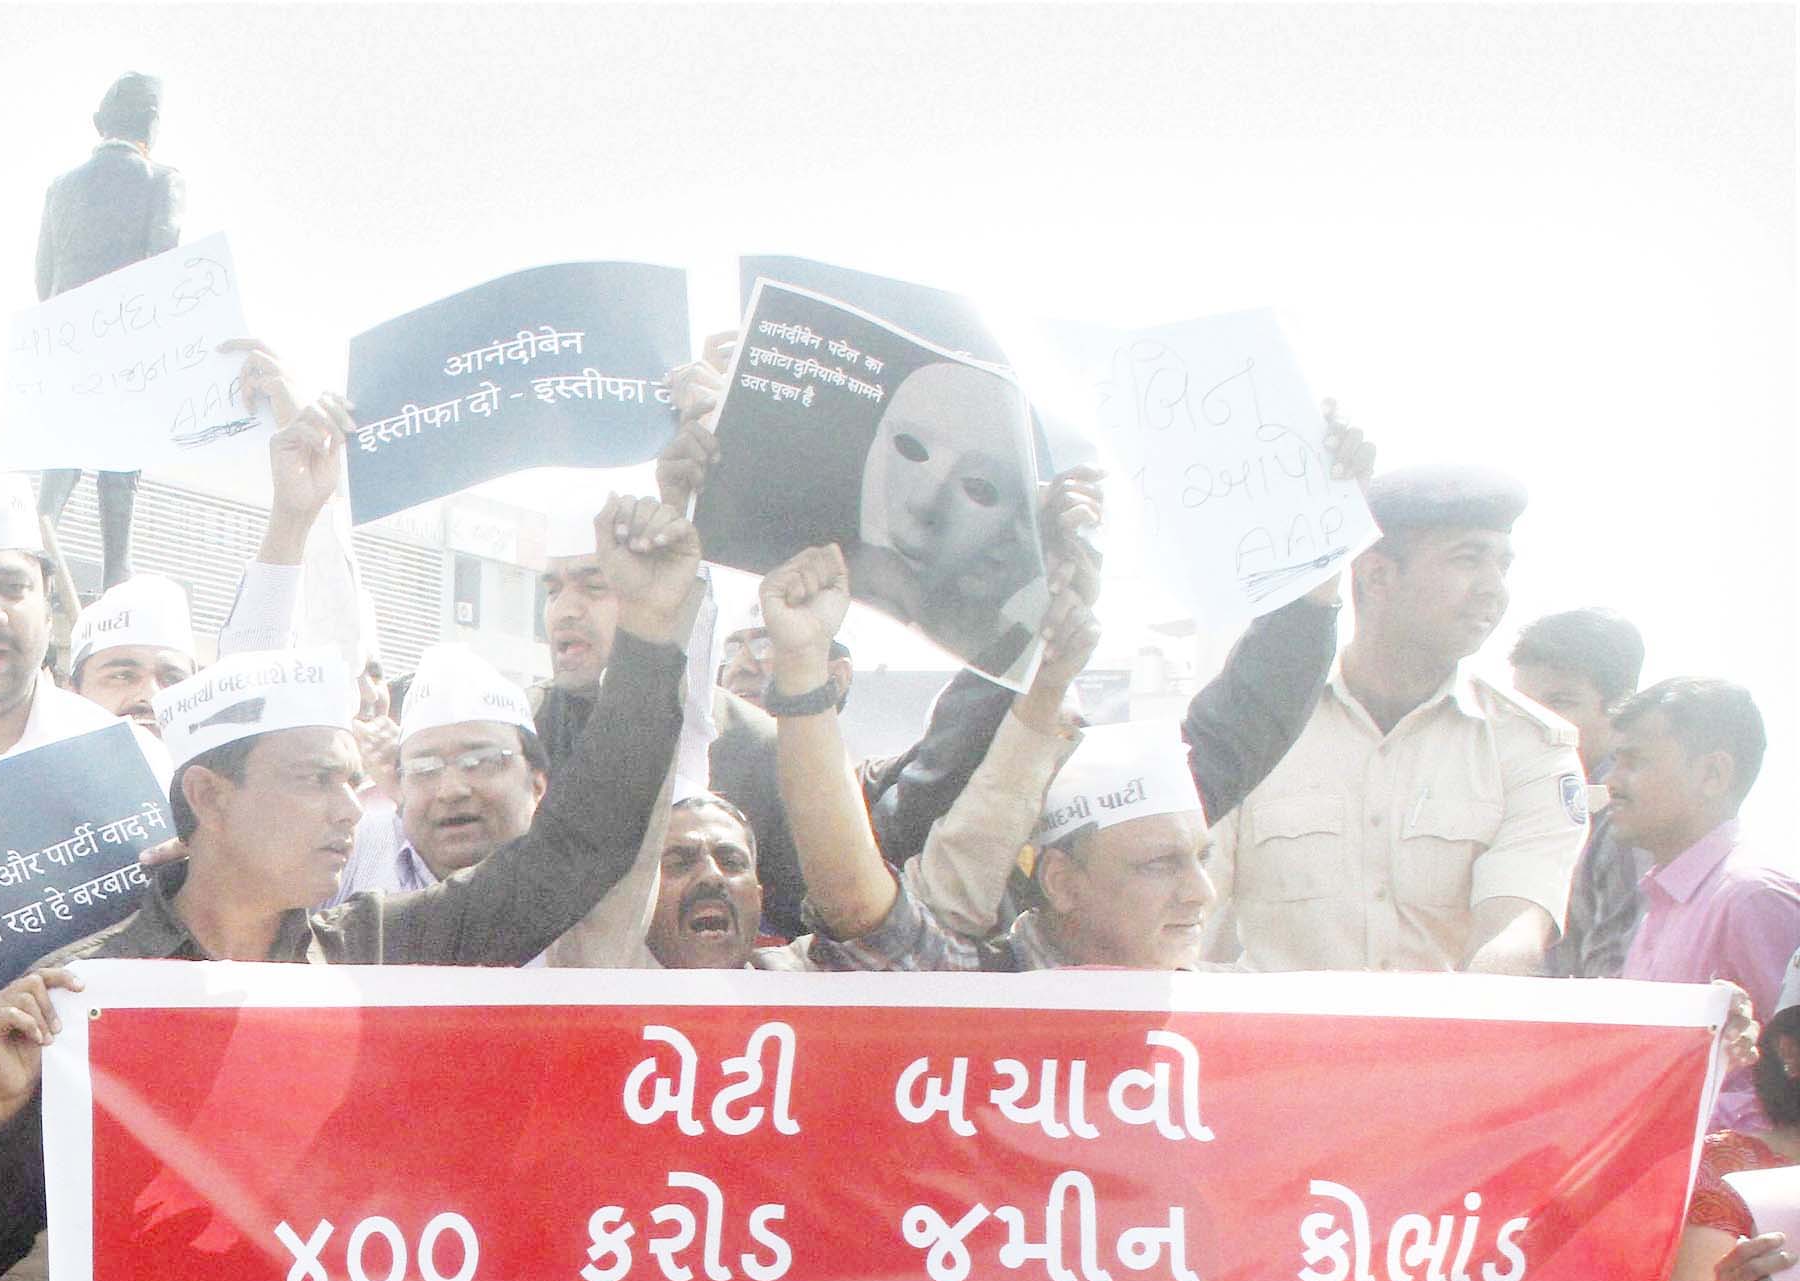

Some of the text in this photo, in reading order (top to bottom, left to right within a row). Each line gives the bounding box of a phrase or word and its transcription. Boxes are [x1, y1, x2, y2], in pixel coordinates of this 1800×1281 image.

[444, 326, 585, 376] आनंदीबेन
[827, 339, 860, 364] पटेल
[864, 356, 884, 375] का
[356, 398, 462, 453] इस्तीफा
[464, 381, 502, 417] दो
[531, 368, 646, 404] इस्तीफा
[1235, 505, 1344, 576] AAP
[44, 822, 99, 867] पार्टी
[97, 815, 148, 845] वाद
[139, 802, 167, 830] में
[2, 901, 47, 933] रहा
[68, 862, 150, 907] बरबाद
[623, 1021, 1216, 1142] બેટી બચાવો
